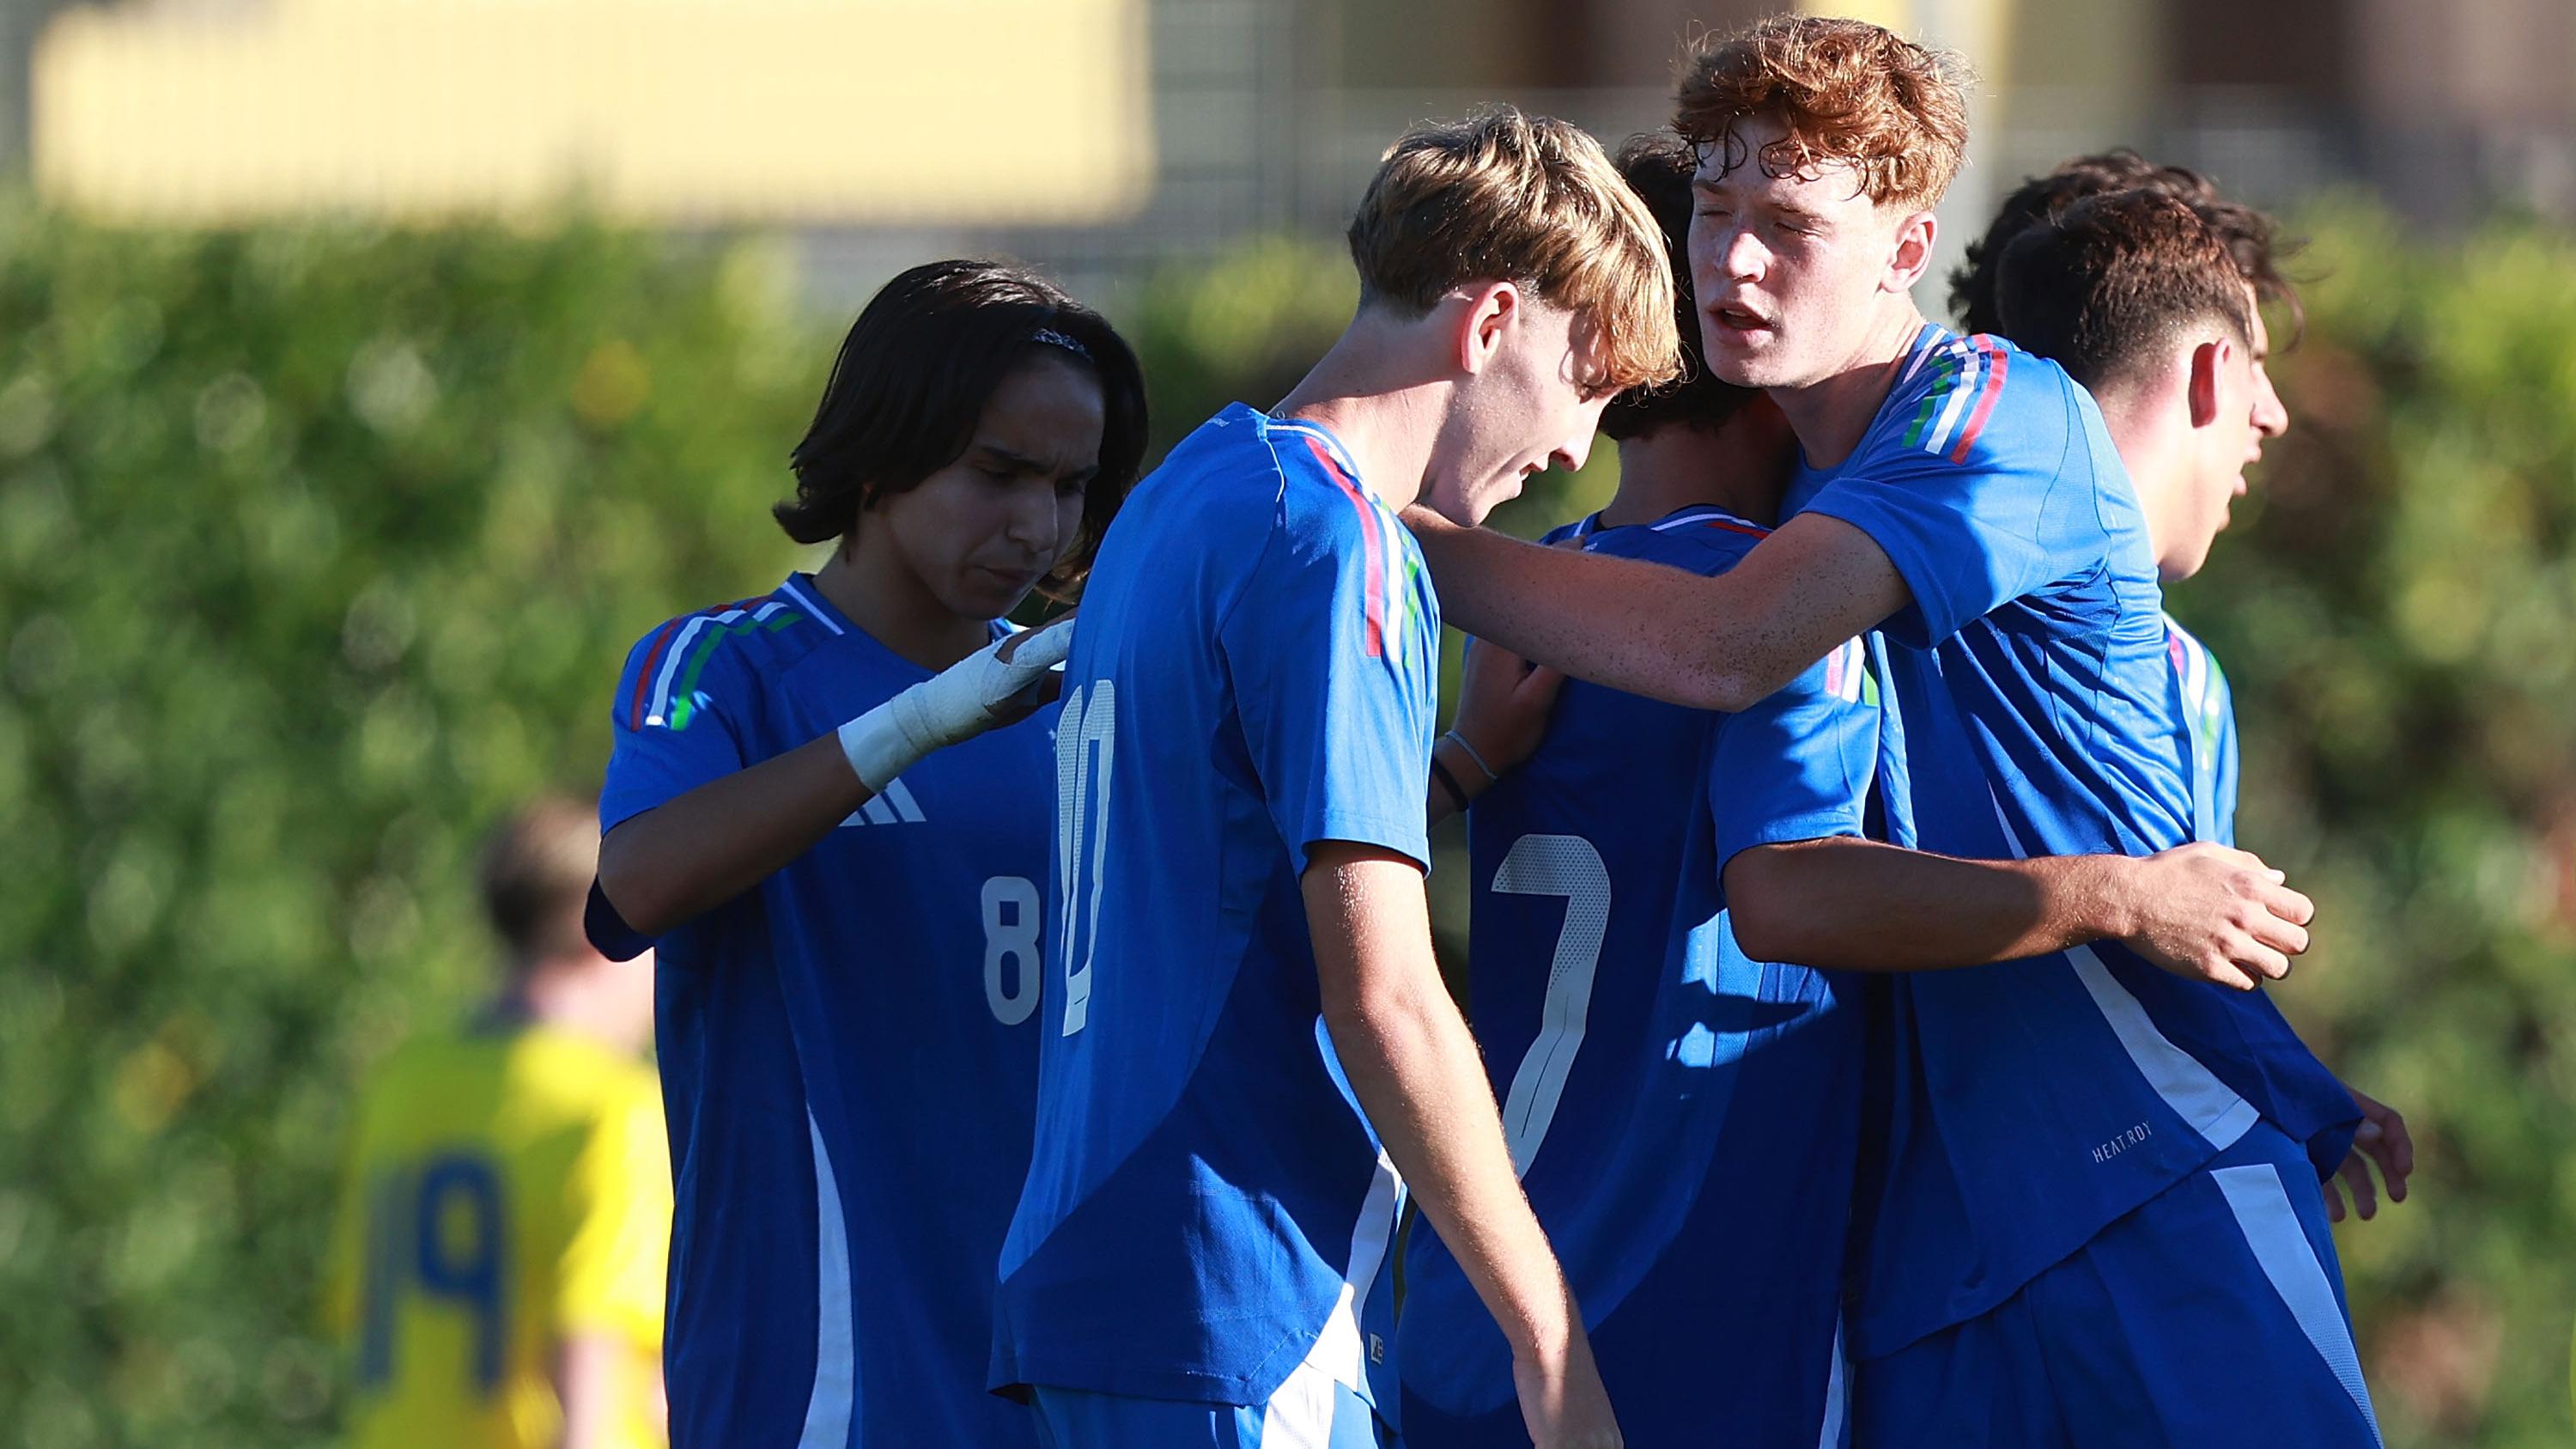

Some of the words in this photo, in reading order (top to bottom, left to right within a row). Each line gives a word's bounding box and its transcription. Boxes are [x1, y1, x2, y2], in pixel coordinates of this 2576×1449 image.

[981, 876, 1040, 1026] 8
[1056, 679, 1115, 1037] 10
[1491, 833, 1611, 1181] 7
[2092, 1120, 2152, 1163] HEAT.RDY
[359, 1146, 510, 1402] 19
